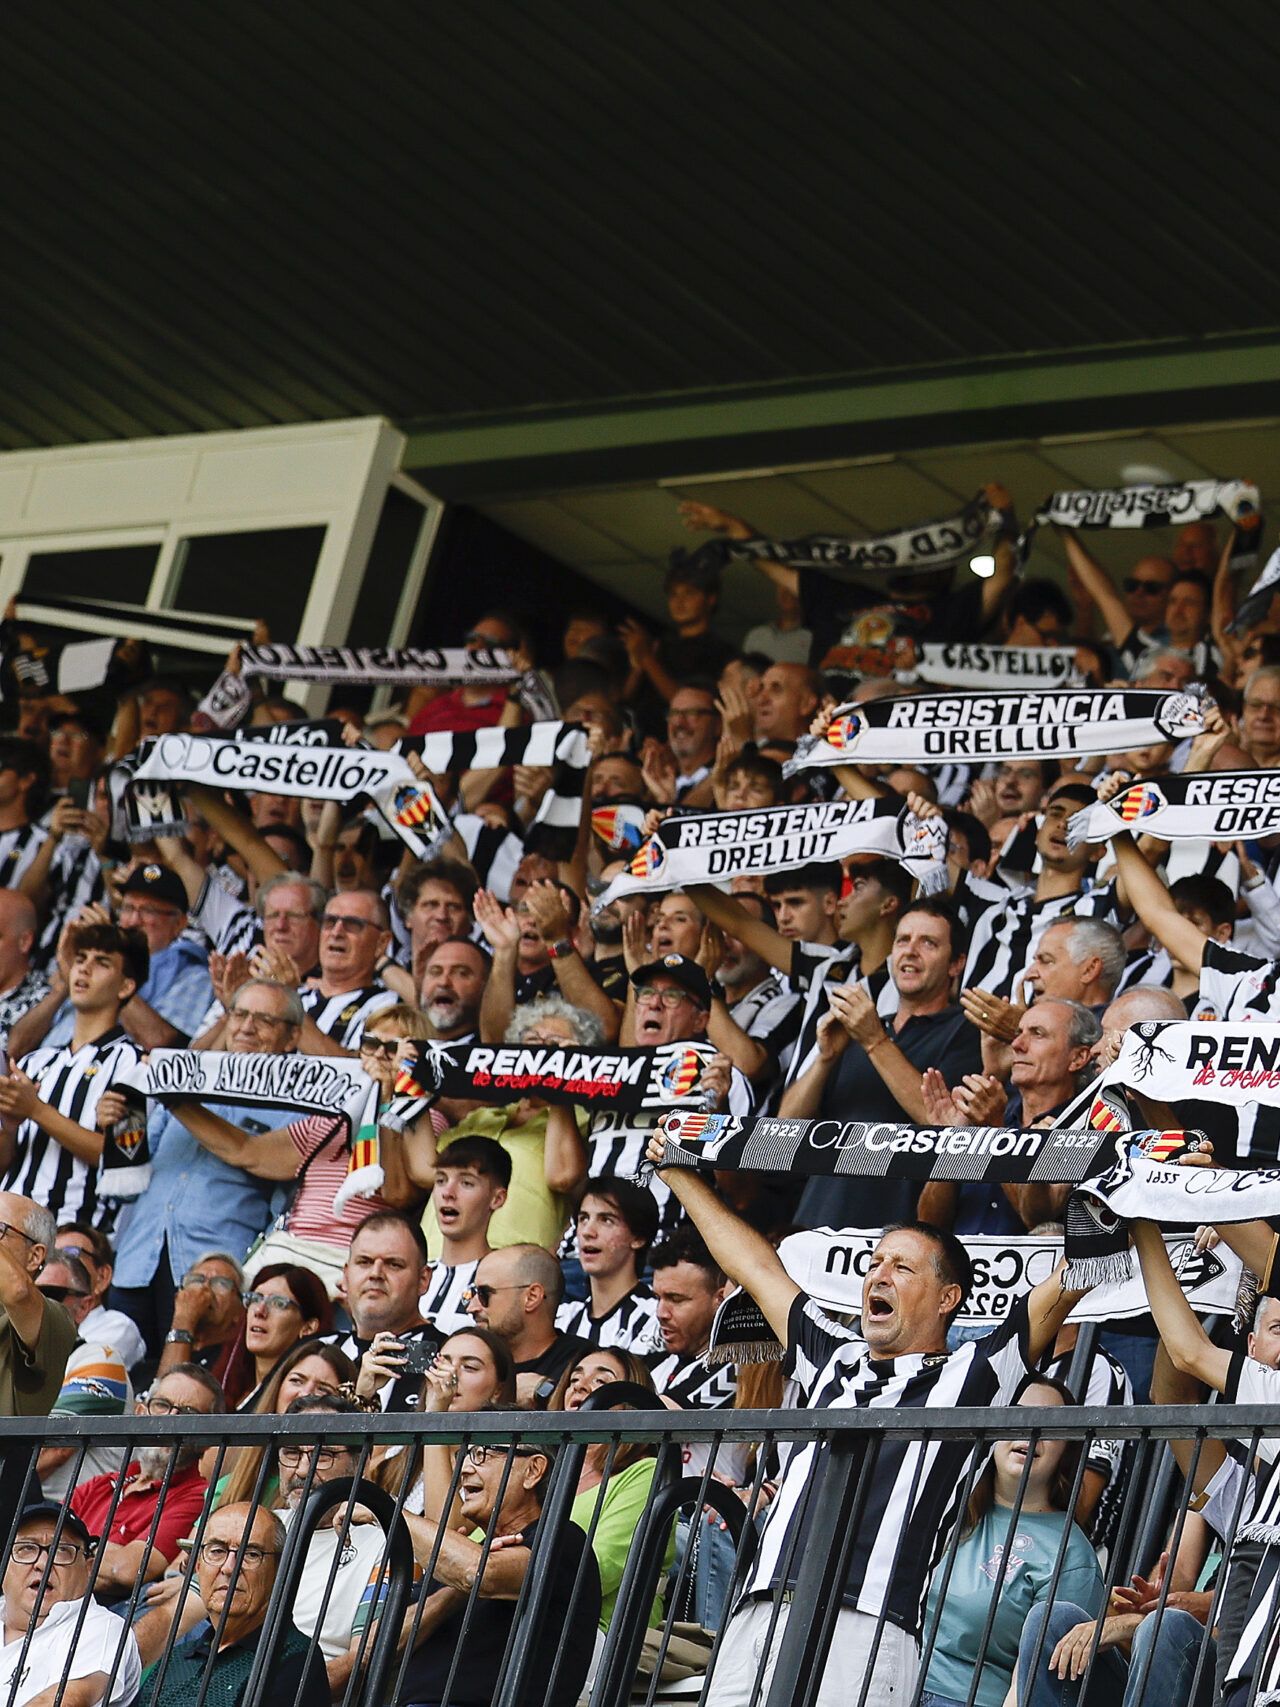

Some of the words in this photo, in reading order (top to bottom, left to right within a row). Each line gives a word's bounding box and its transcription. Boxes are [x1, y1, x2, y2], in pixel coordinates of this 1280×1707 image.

[887, 693, 1127, 728] RESISTÈNCIA
[924, 724, 1083, 755] ORELLUT
[707, 831, 839, 875] ORELLUT
[146, 1050, 207, 1093] 100%
[214, 1053, 362, 1112] ALBINEGROS
[464, 1048, 647, 1086] RENAIXEM
[1193, 1060, 1216, 1087] de
[762, 1123, 801, 1138] 1922
[1053, 1135, 1100, 1149] 2022
